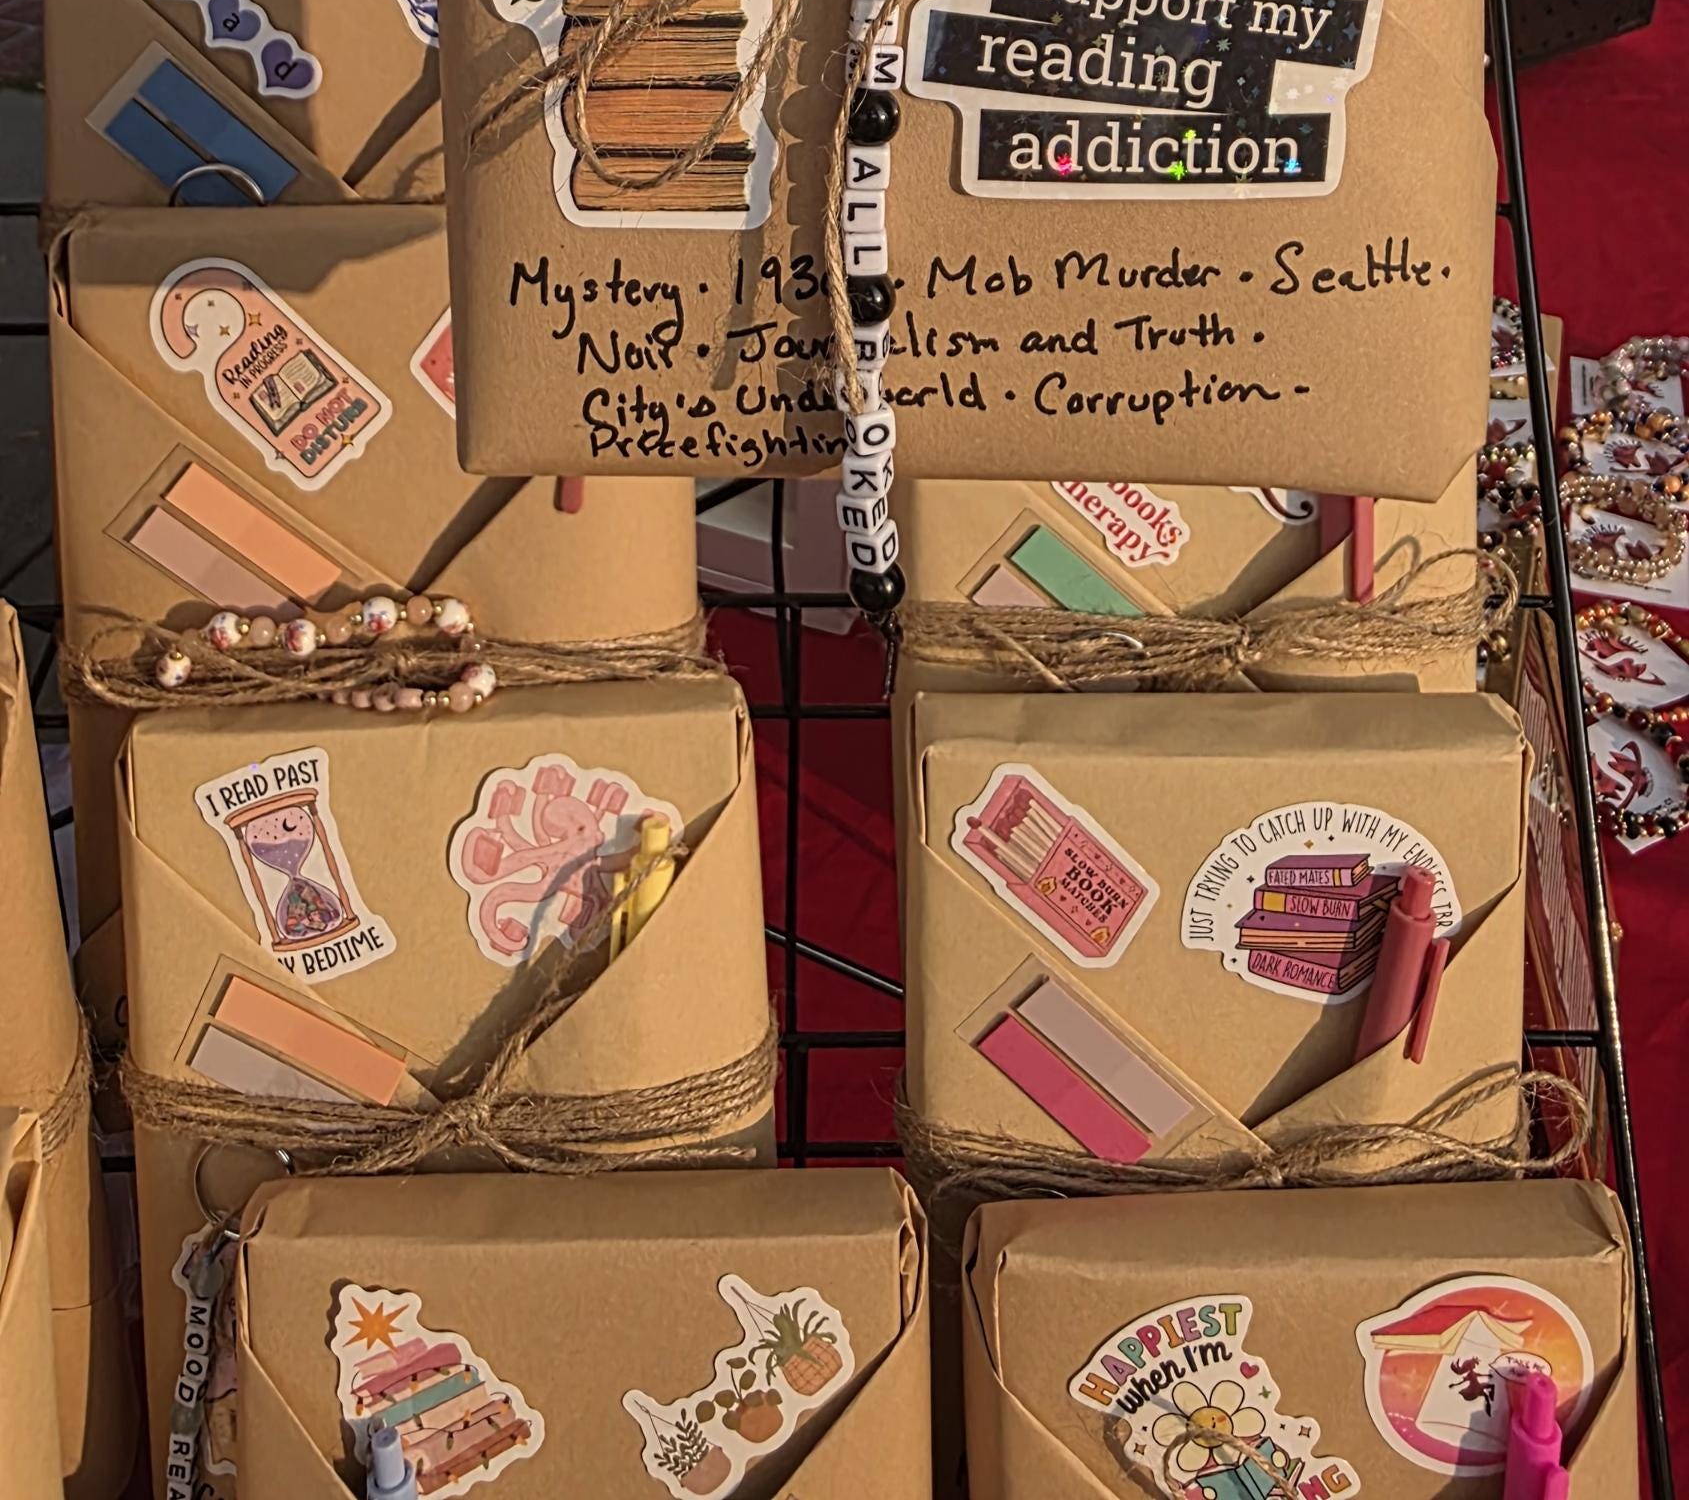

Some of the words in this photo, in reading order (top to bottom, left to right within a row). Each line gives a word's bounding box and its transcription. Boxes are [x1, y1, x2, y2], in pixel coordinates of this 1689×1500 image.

[1247, 0, 1333, 50] my
[977, 32, 1223, 110] reading
[1009, 119, 1302, 175] addiction
[847, 156, 881, 265] ALL
[510, 256, 684, 346] Mystery
[735, 254, 831, 304] 193
[928, 255, 1033, 298] Mob
[1056, 247, 1221, 290] Murder
[222, 324, 288, 385] Reading
[239, 375, 253, 389] IN
[250, 339, 288, 381] PROGRESS
[578, 330, 673, 375] Noir
[1020, 318, 1098, 357] and
[1115, 313, 1235, 351] Truth
[290, 423, 320, 451] DO
[315, 387, 353, 425] NOT
[300, 397, 368, 466] DISTURB
[583, 384, 717, 450] City's
[1035, 369, 1281, 425] Corruption
[1058, 480, 1170, 562] herapy
[206, 794, 220, 817] I
[219, 774, 269, 810] READ
[273, 759, 320, 791] PAST
[1230, 833, 1257, 857] TO
[1258, 809, 1306, 844] CATCH
[1313, 807, 1333, 831] UP
[1342, 810, 1381, 840] WITH
[1381, 824, 1409, 853] MY
[1061, 877, 1109, 923] MATCHES
[1064, 847, 1099, 878] SLOW
[1097, 879, 1129, 909] BURN
[1065, 865, 1119, 915] BOOK
[1194, 853, 1240, 902] TRYING
[1269, 869, 1297, 886] FATED
[1299, 869, 1330, 886] MATES
[1189, 907, 1214, 941] JUST
[1290, 896, 1319, 914] SLOW
[1322, 900, 1352, 918] BURN
[302, 926, 384, 975] BEDTIME
[1252, 952, 1279, 975] DARK
[1284, 957, 1338, 990] ROMANCE
[177, 1304, 208, 1404] MOOD
[1079, 1303, 1242, 1406] HAPPIEST
[1116, 1357, 1186, 1414] when
[1183, 1340, 1232, 1373] I'm
